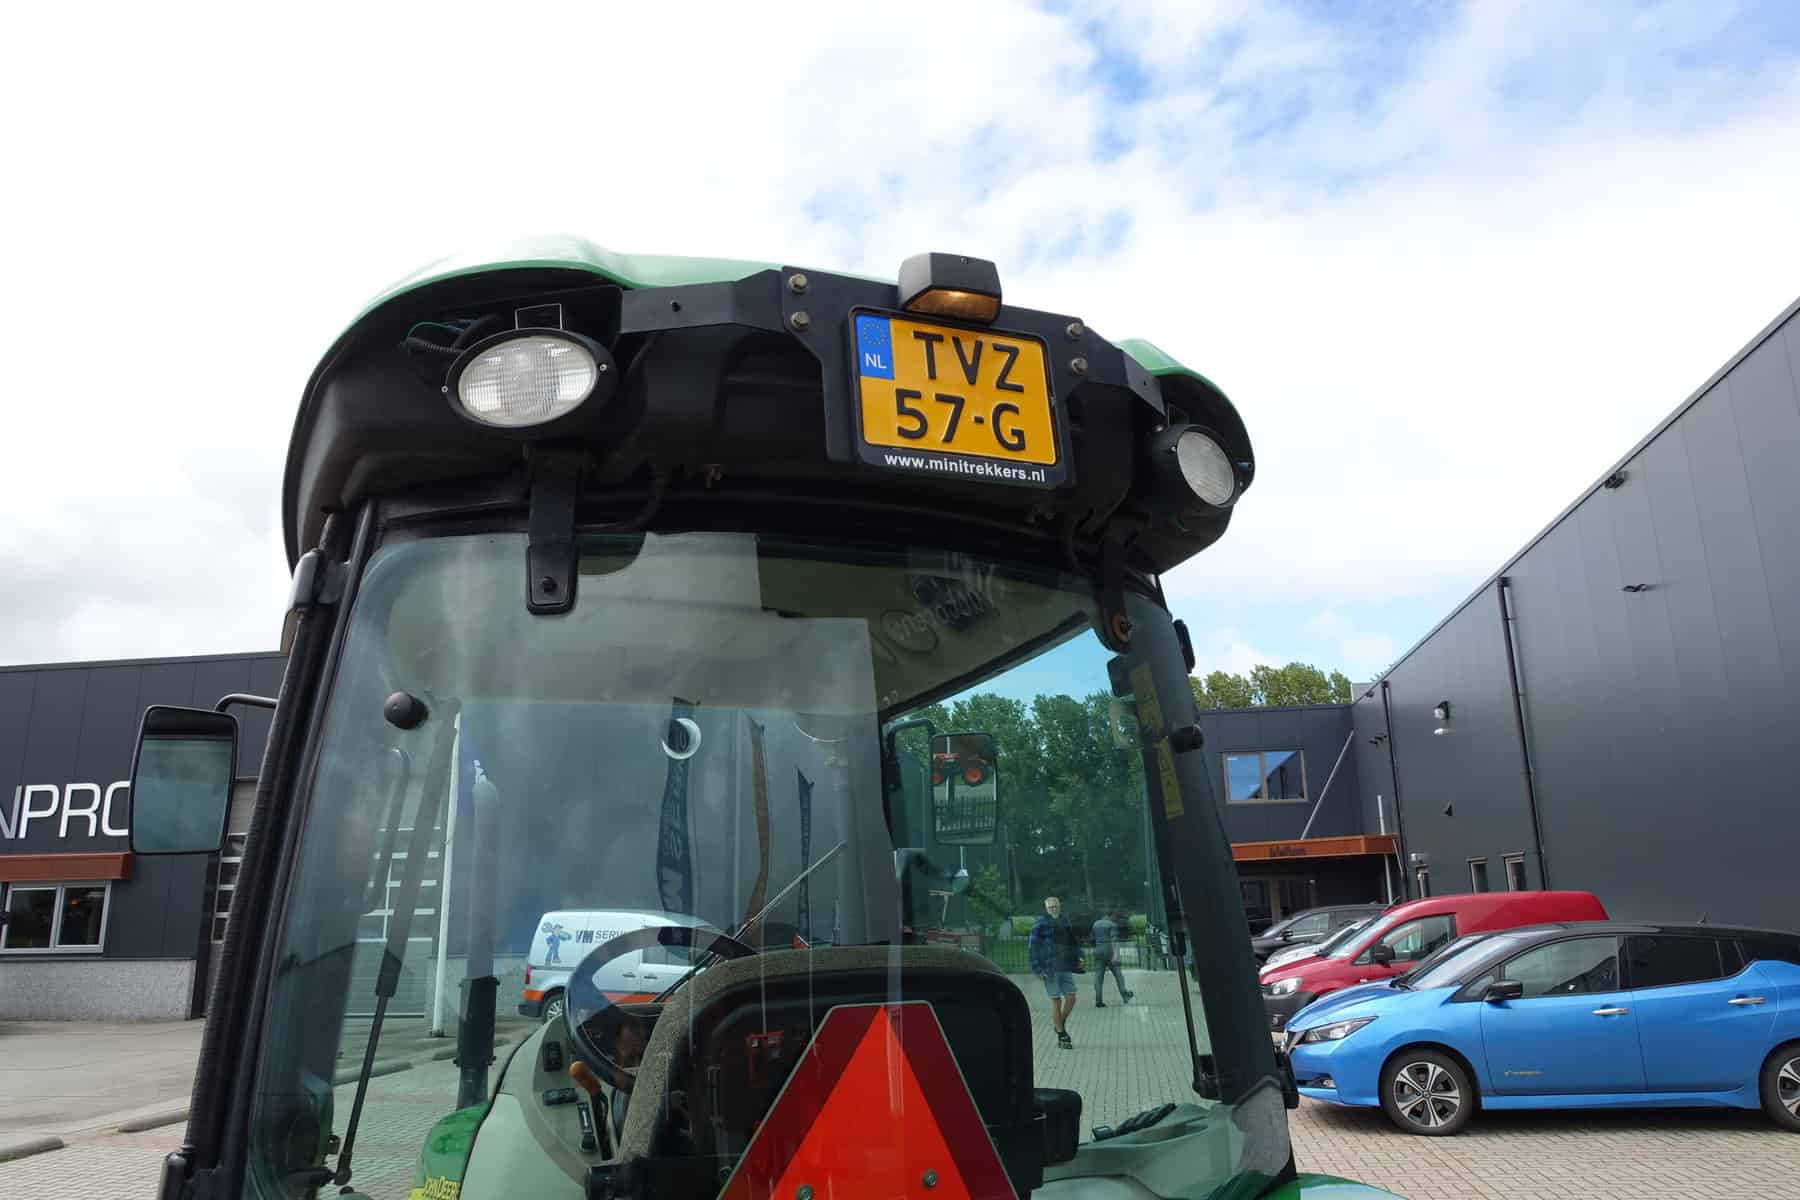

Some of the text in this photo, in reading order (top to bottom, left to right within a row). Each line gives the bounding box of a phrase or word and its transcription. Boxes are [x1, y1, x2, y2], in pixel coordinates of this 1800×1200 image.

[864, 352, 887, 369] NL
[912, 330, 1025, 393] TVZ
[895, 388, 1026, 451] 57-G
[884, 453, 1046, 483] www.minitrekkers.nl
